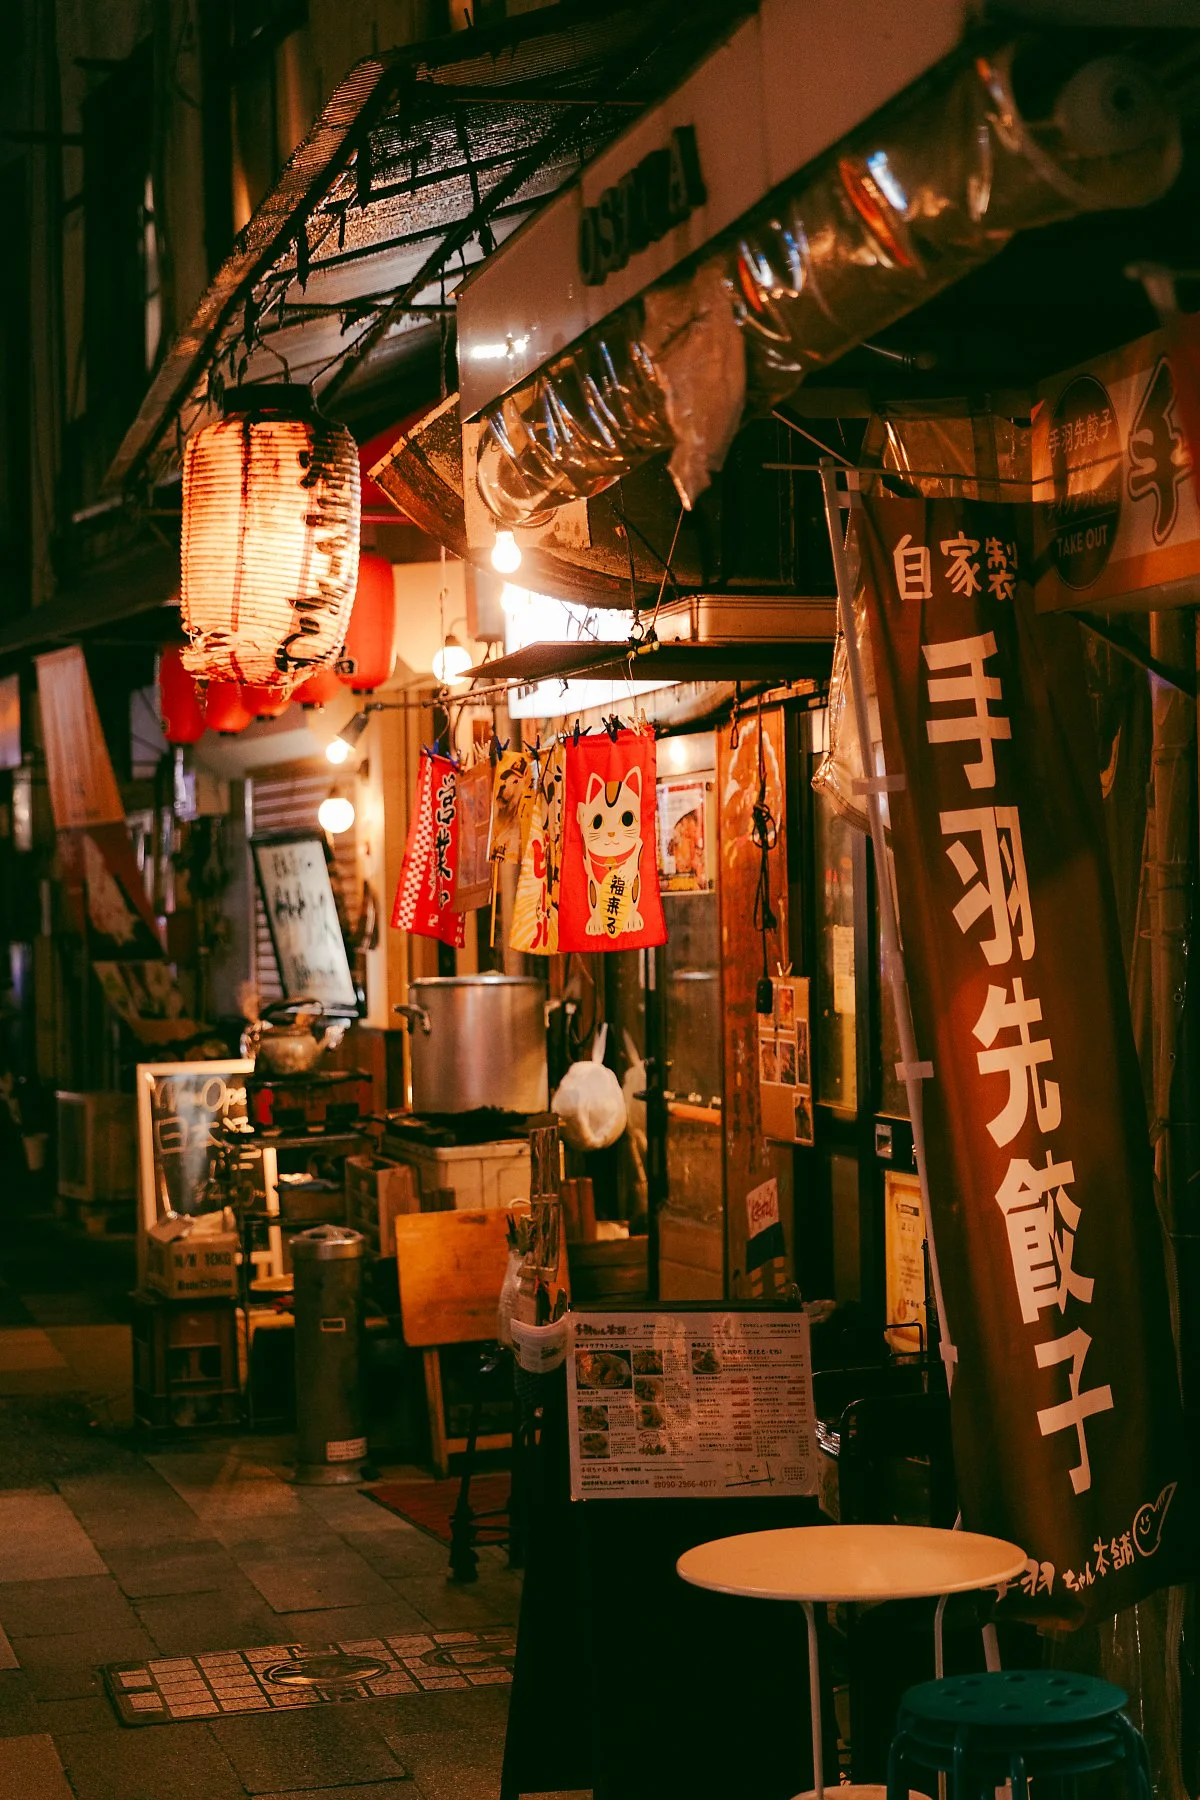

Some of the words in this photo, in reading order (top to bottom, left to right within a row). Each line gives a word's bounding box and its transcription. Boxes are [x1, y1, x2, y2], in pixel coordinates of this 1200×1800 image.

[1048, 407, 1113, 458] 手羽先餃子
[893, 530, 1019, 601] 自家製
[1056, 531, 1084, 557] TAKE
[1085, 524, 1109, 551] OUT
[606, 874, 625, 936] 福来る
[922, 630, 1115, 1495] 手羽先餃子
